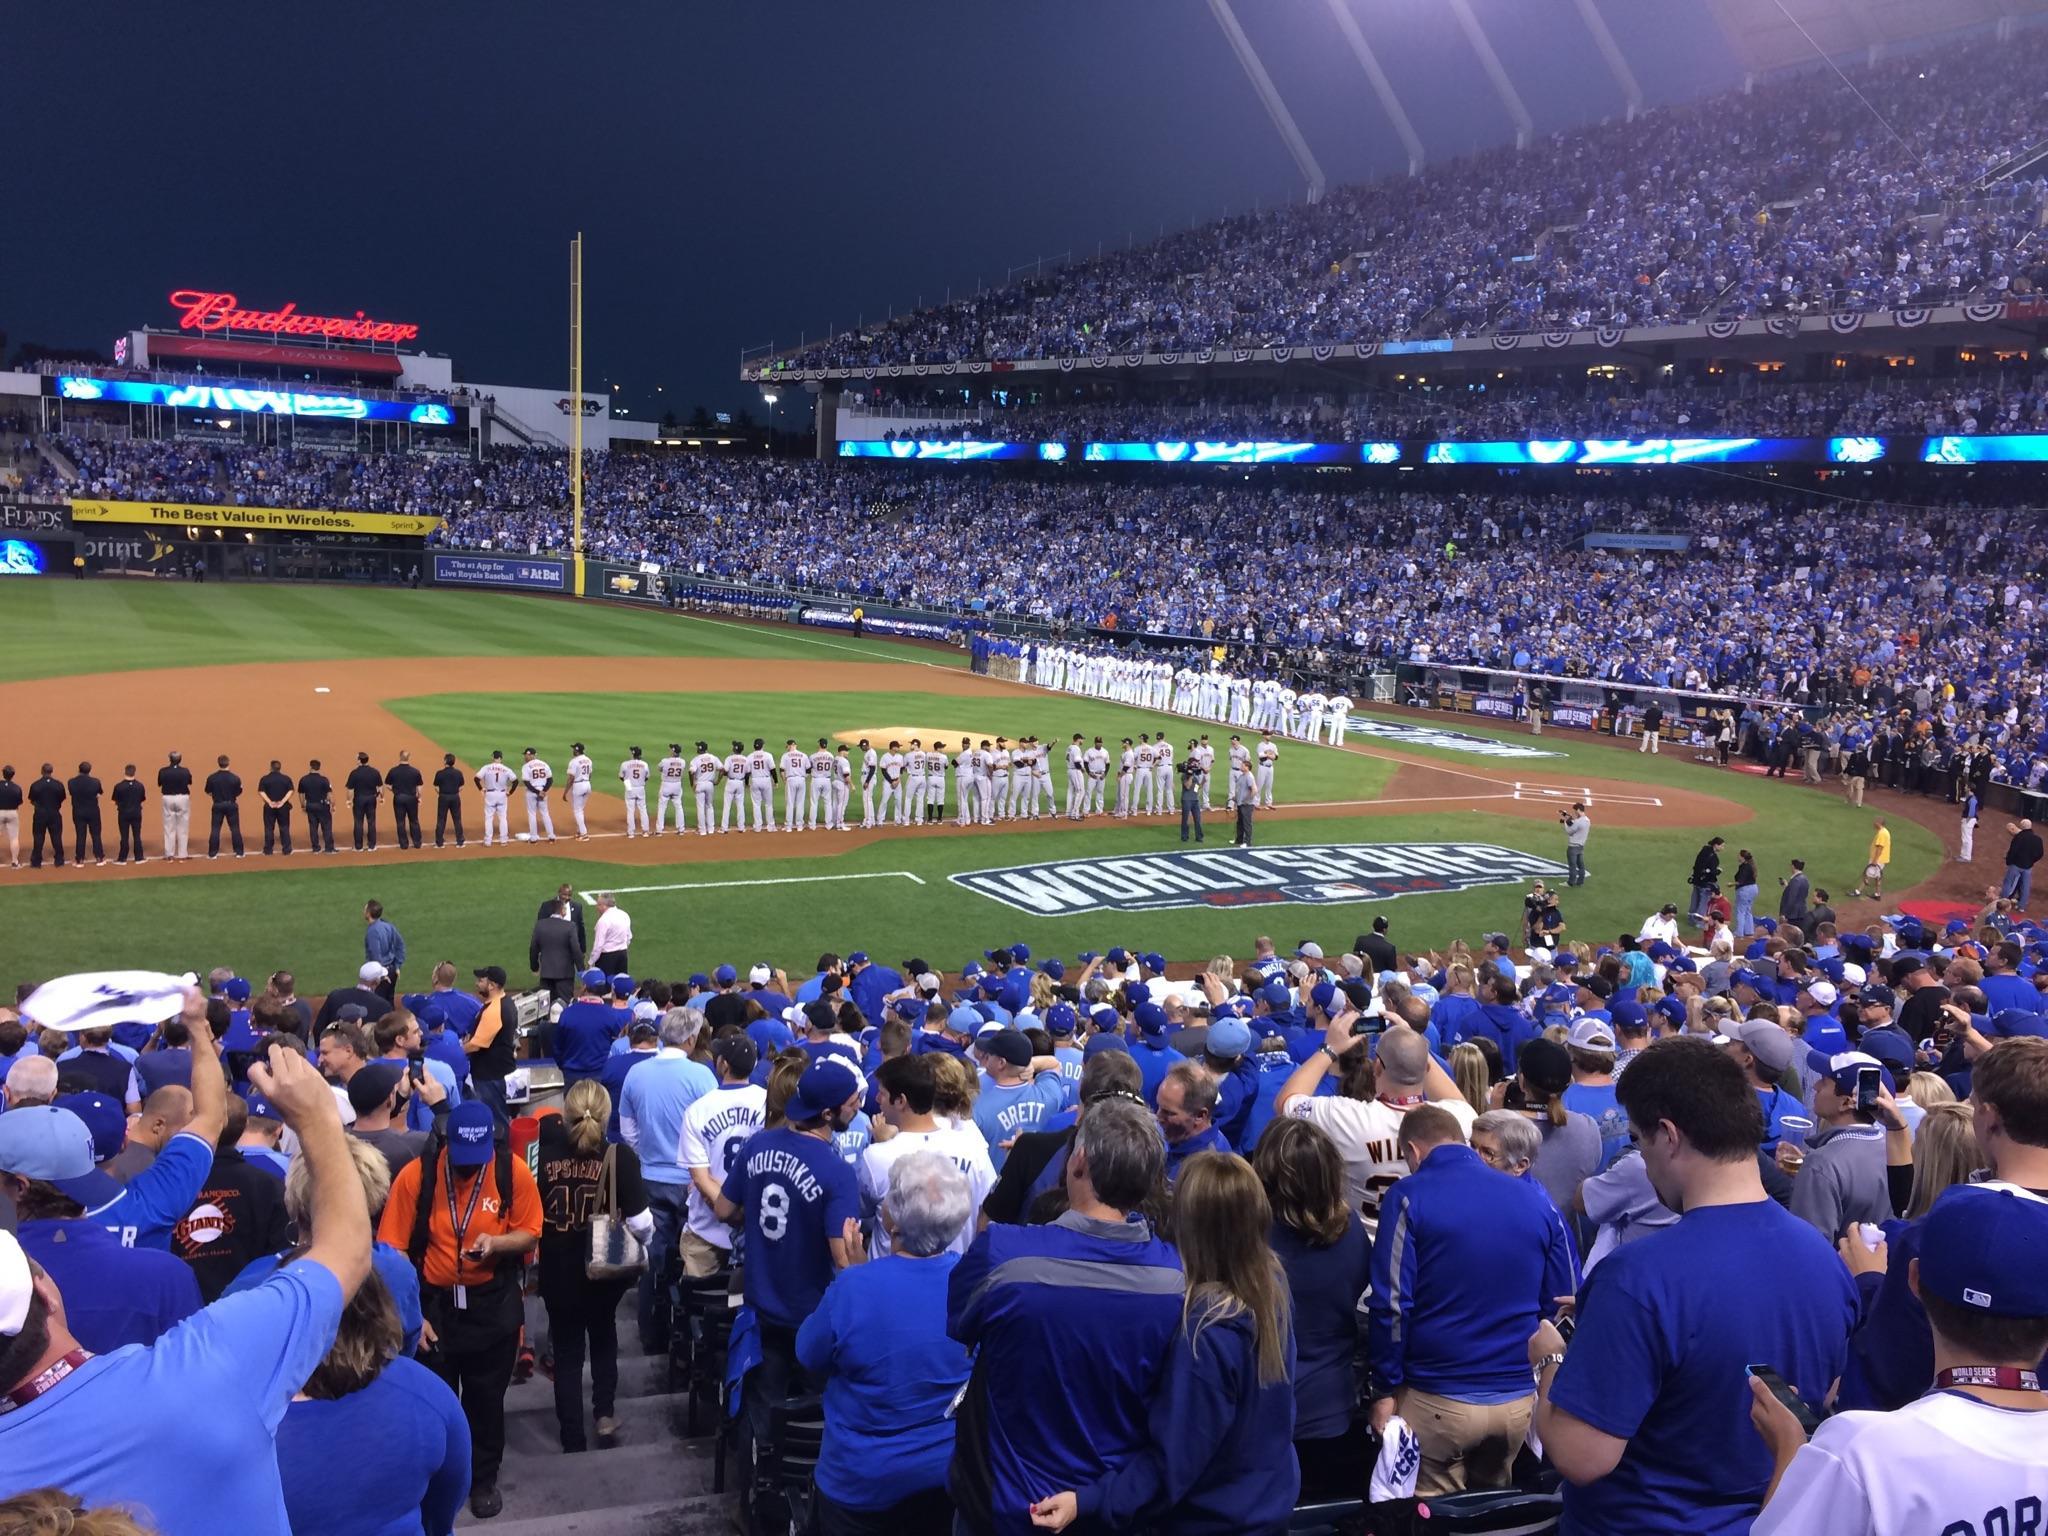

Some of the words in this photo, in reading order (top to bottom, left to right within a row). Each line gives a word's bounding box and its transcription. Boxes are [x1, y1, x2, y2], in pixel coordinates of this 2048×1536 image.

[170, 291, 418, 342] Budweiser
[151, 507, 180, 519] The
[184, 508, 218, 521] Best
[222, 510, 265, 523] Value
[269, 513, 282, 524] in
[286, 514, 355, 528] Wireless.
[391, 521, 414, 530] Sprint
[86, 536, 142, 559] print
[451, 560, 466, 570] The
[467, 562, 476, 570] #1
[476, 562, 492, 572] App
[493, 563, 504, 571] for
[440, 569, 456, 578] Live
[458, 571, 483, 581] Royals
[484, 572, 514, 581] Baseball
[1476, 700, 1494, 711] WORLD
[1494, 700, 1513, 716] SERIES
[1553, 710, 1571, 721] WORLD
[1572, 710, 1592, 722] SERIES
[792, 758, 802, 768] 51
[1140, 753, 1152, 762] 50
[582, 765, 590, 775] 31
[700, 762, 714, 774] 39
[732, 764, 744, 774] 21
[753, 760, 764, 770] 91
[816, 762, 830, 772] 60
[914, 760, 925, 770] 37
[928, 762, 940, 771] 56
[532, 768, 546, 779] 65
[632, 769, 640, 779] 5
[667, 768, 682, 777] 23
[969, 853, 1288, 911] WORLD
[1248, 846, 1569, 880] SERIES
[997, 1101, 1045, 1131] BRETT
[701, 1107, 766, 1143] MOUSTAK
[837, 1131, 864, 1148] RETT
[1366, 1138, 1405, 1164] WIL
[546, 1160, 603, 1182] EPSTEIN
[747, 1150, 823, 1203] MOUSTAKAS
[482, 1197, 499, 1214] KC
[759, 1182, 790, 1242] 8
[172, 1215, 235, 1239] GIANTS
[1952, 1367, 1972, 1376] WORLD
[1974, 1367, 1996, 1377] SERIES
